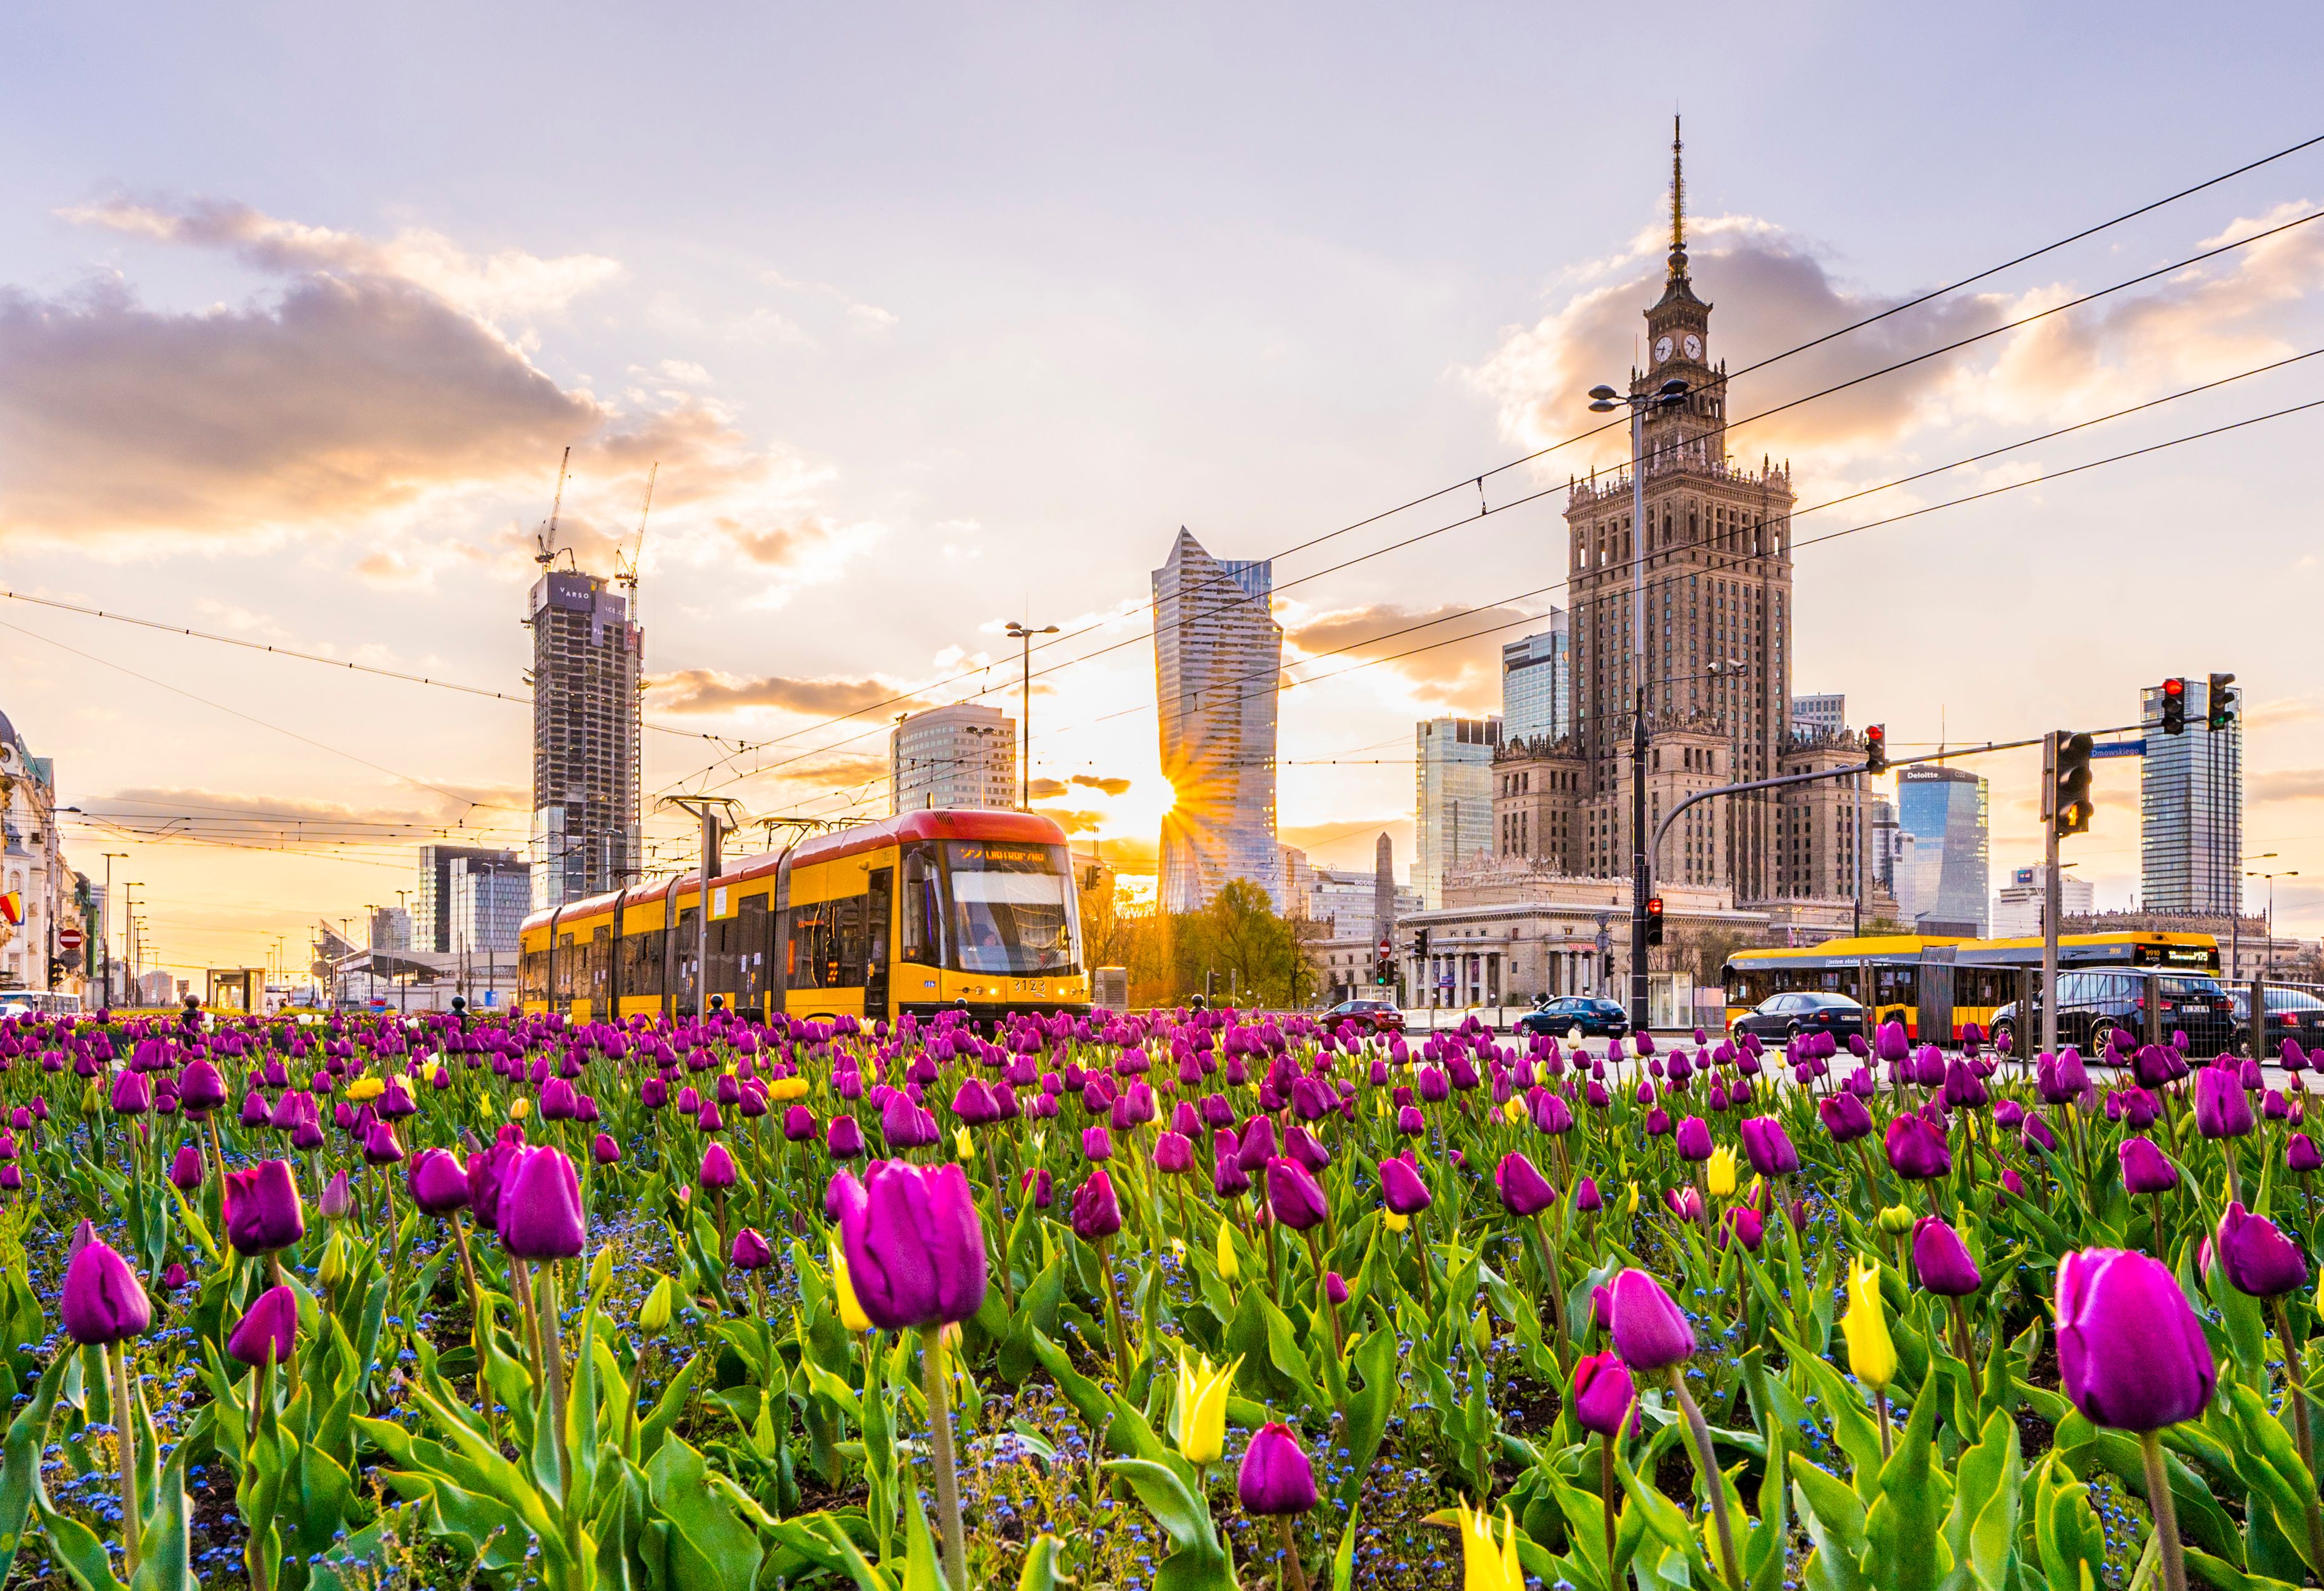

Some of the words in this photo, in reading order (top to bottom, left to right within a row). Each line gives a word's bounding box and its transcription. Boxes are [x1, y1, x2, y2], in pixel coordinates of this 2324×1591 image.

[560, 586, 589, 599] VARSO
[2092, 747, 2139, 757] Dmowskiego
[1012, 979, 1046, 992] 3123
